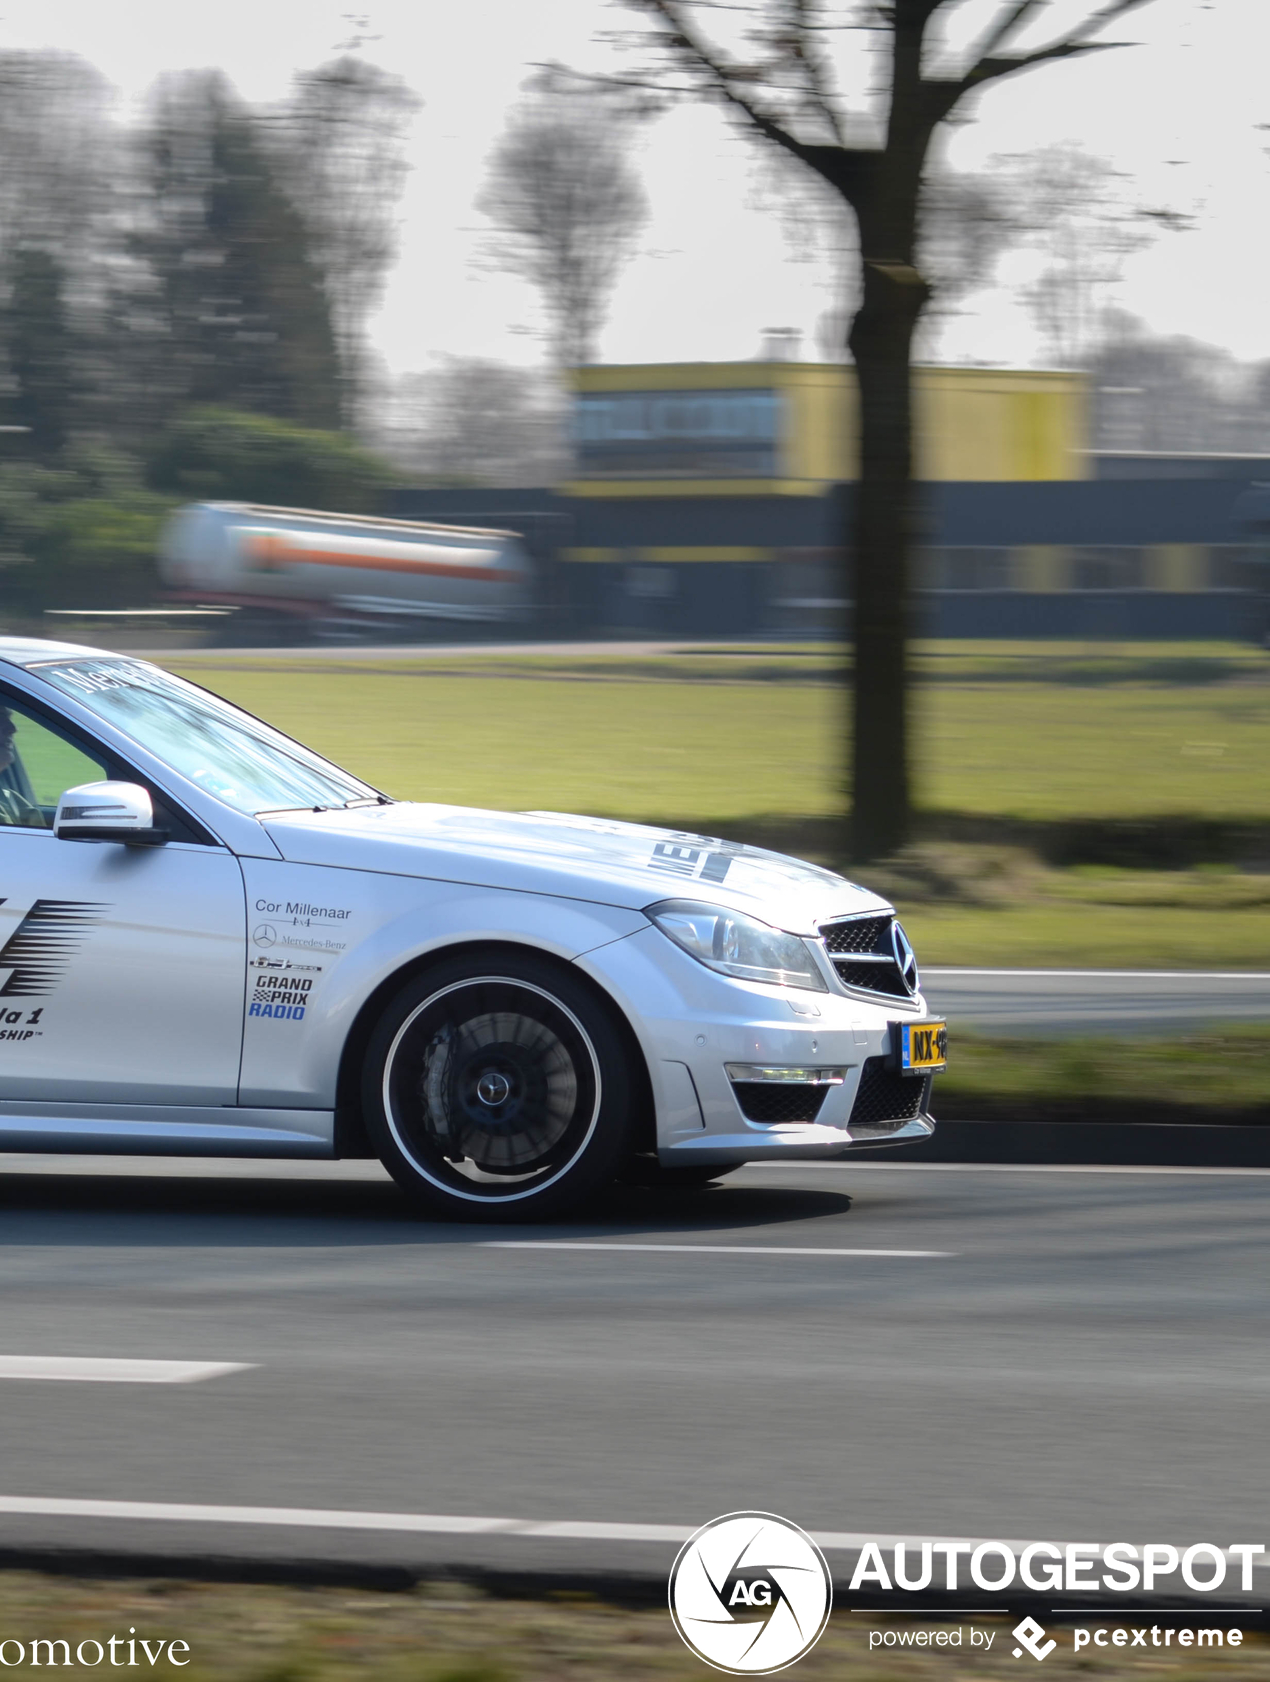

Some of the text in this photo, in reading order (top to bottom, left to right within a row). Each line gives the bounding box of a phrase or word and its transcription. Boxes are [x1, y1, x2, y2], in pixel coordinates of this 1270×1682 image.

[255, 899, 352, 919] Cor Millenaar
[281, 935, 347, 950] Mercedes-Benz
[256, 975, 313, 991] GRAND
[270, 990, 309, 1006] PRIX
[25, 1007, 45, 1025] 1
[248, 1003, 306, 1020] RADIO
